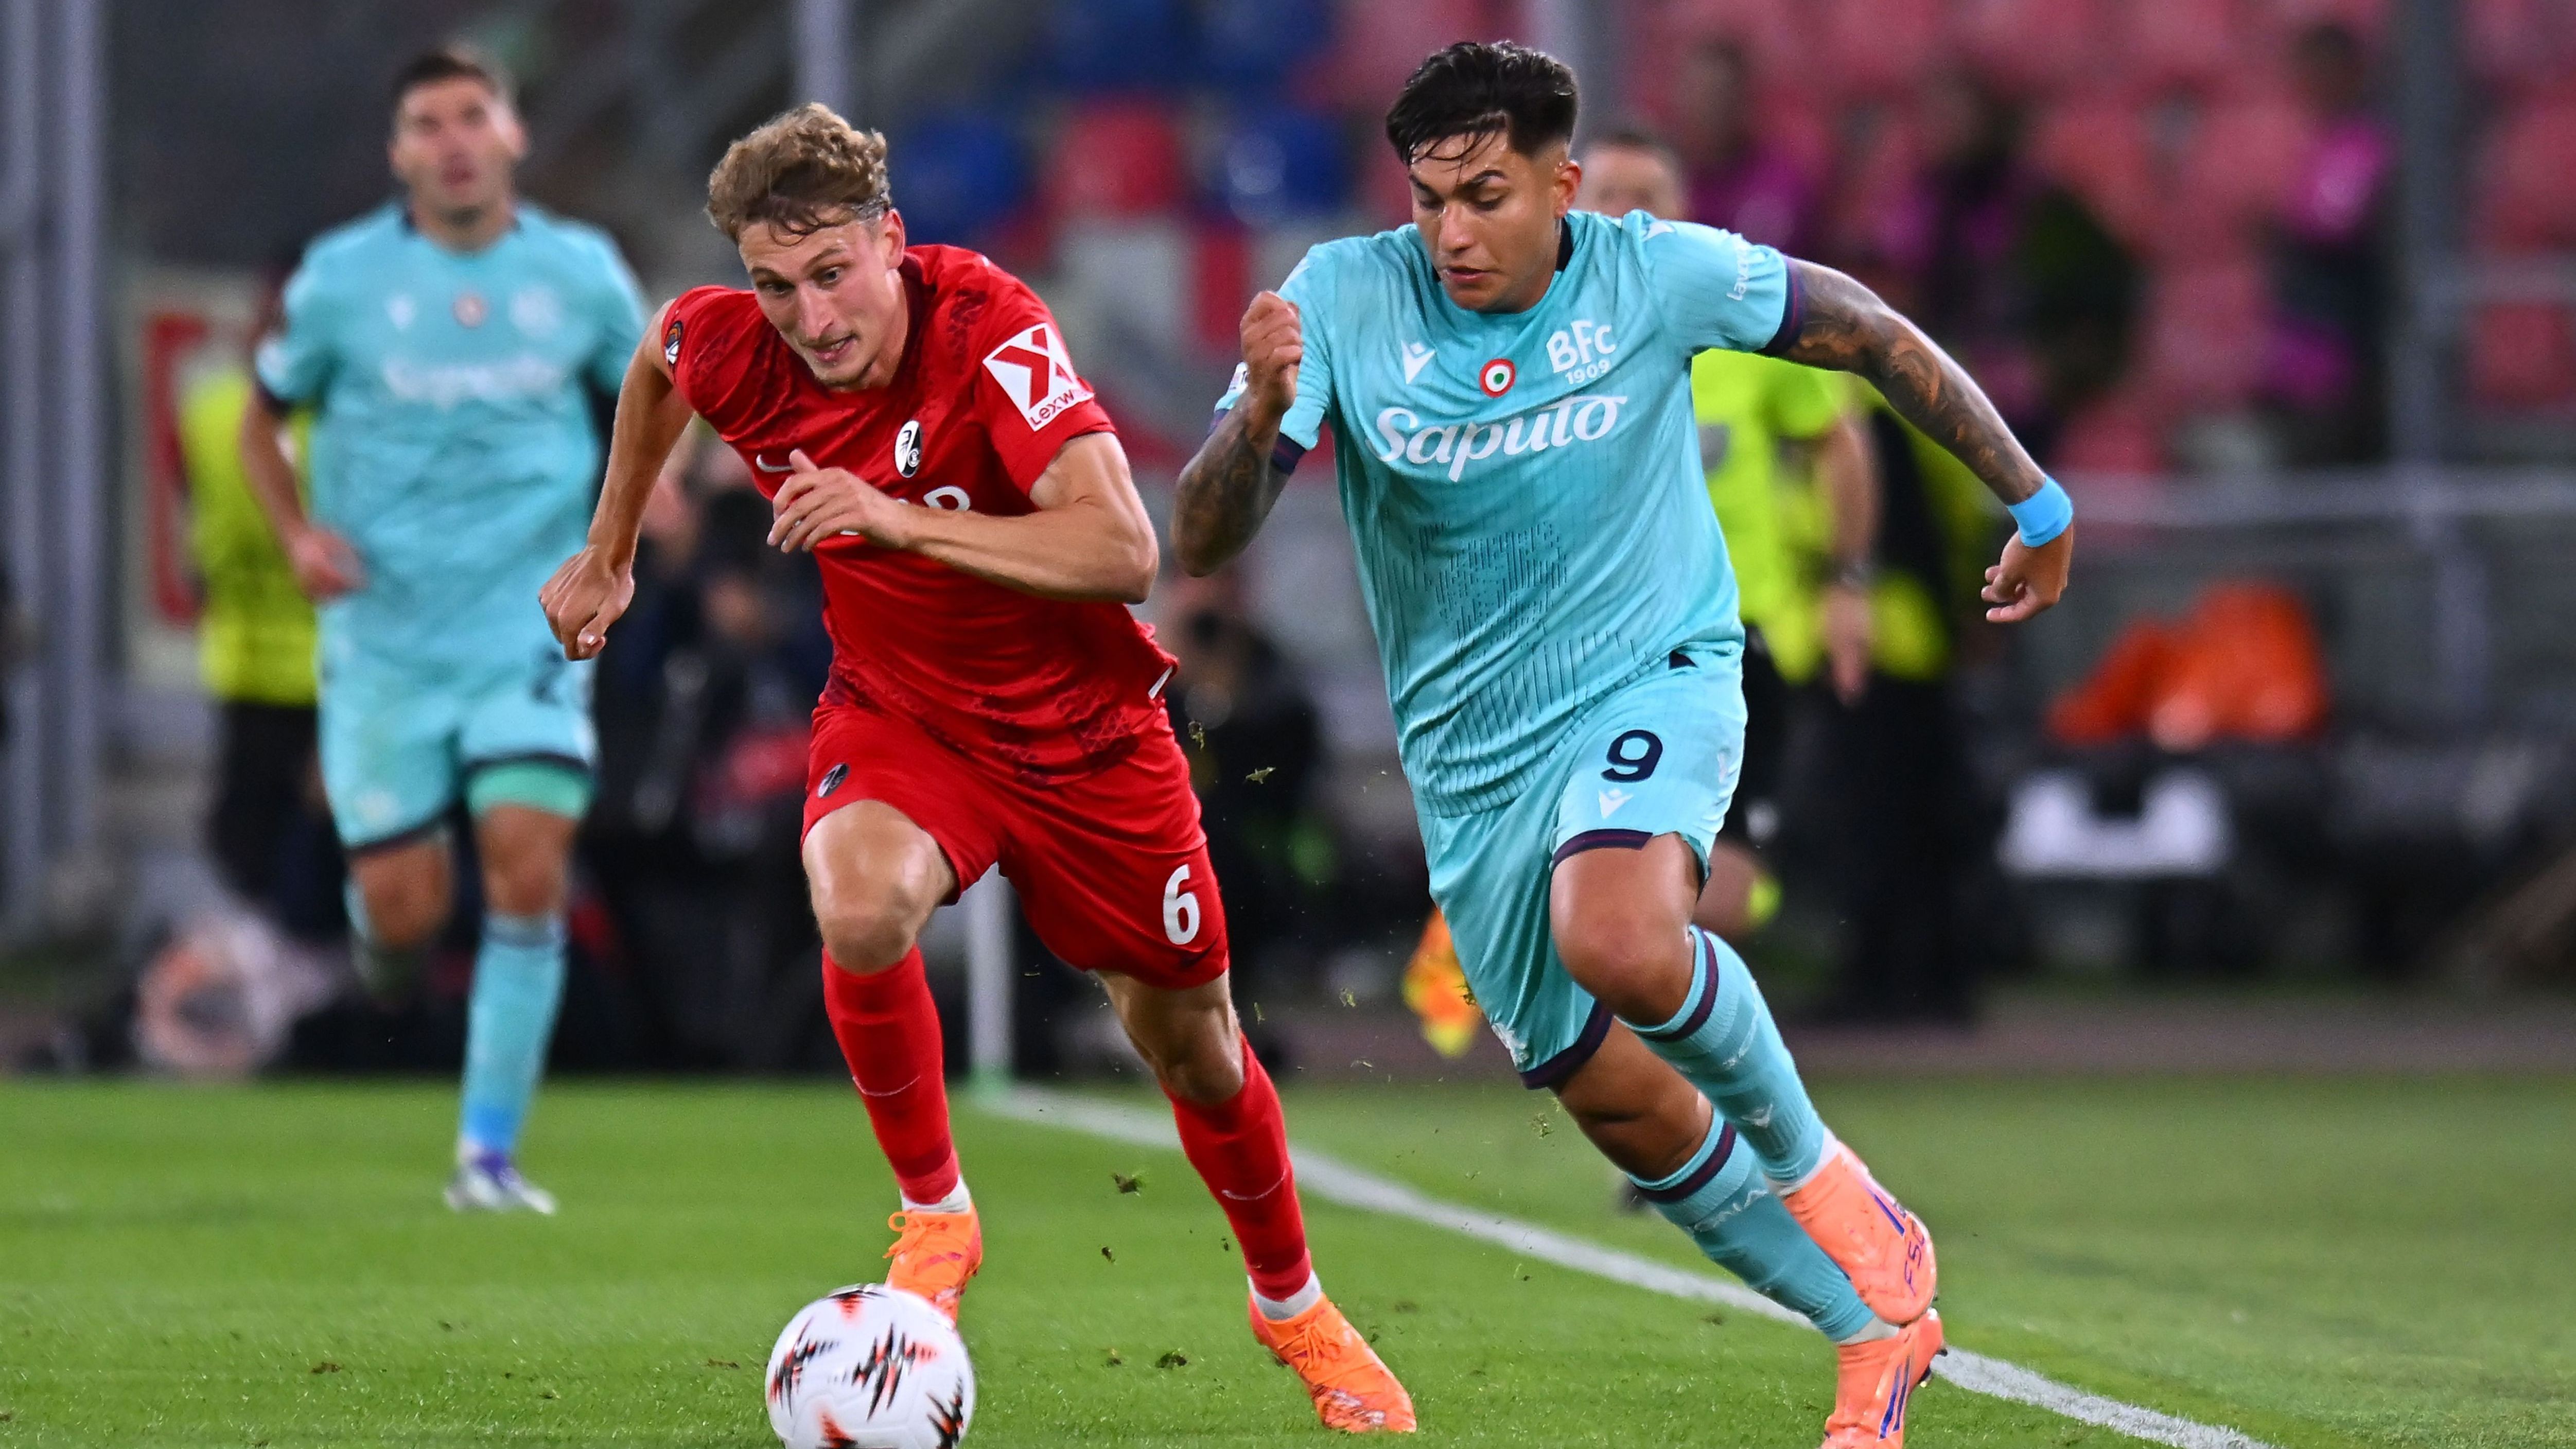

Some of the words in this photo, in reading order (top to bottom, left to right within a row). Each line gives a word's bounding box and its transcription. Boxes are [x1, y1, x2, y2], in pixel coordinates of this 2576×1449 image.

[1565, 359, 1610, 385] 1909
[1030, 388, 1087, 427] Lexw
[1365, 394, 1627, 482] Saputo
[1601, 729, 1663, 783] 9
[1163, 864, 1200, 945] 6
